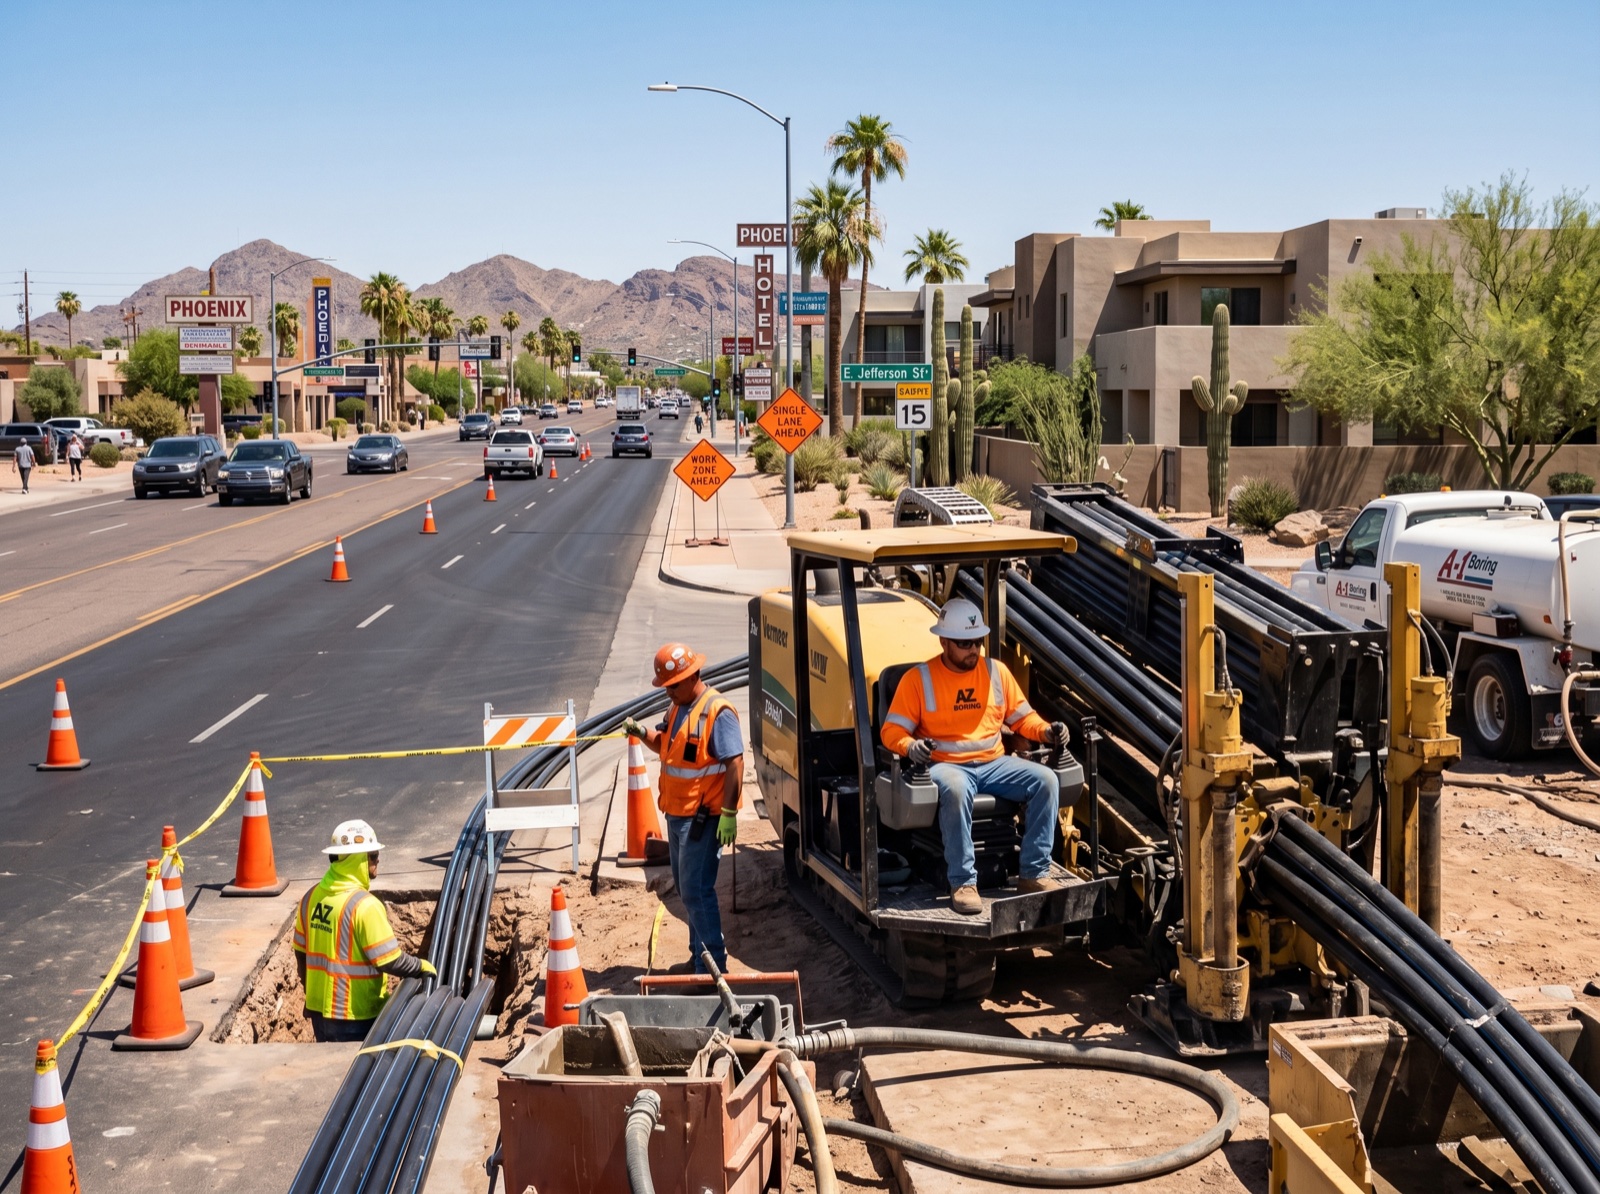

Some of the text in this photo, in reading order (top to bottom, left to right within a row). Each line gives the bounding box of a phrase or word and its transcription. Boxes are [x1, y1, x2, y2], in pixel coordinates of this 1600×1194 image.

[740, 227, 803, 243] PHOEI
[170, 300, 247, 317] PHOENIX
[757, 258, 772, 346] HOTEL
[843, 367, 853, 379] E.
[857, 367, 907, 379] Jefferson
[772, 405, 807, 415] SINGLE
[902, 404, 926, 425] 15
[777, 417, 803, 426] LANE
[774, 428, 807, 438] AHEAD
[691, 455, 717, 464] WORK
[692, 465, 717, 475] ZONE
[690, 476, 721, 486] AHEAD
[1437, 549, 1498, 580] A-1 Boring
[1335, 580, 1366, 598] A-1 Boring
[762, 614, 789, 648] Vermeer
[955, 688, 977, 704] AZ
[953, 702, 982, 711] BORING
[311, 902, 334, 925] AZ
